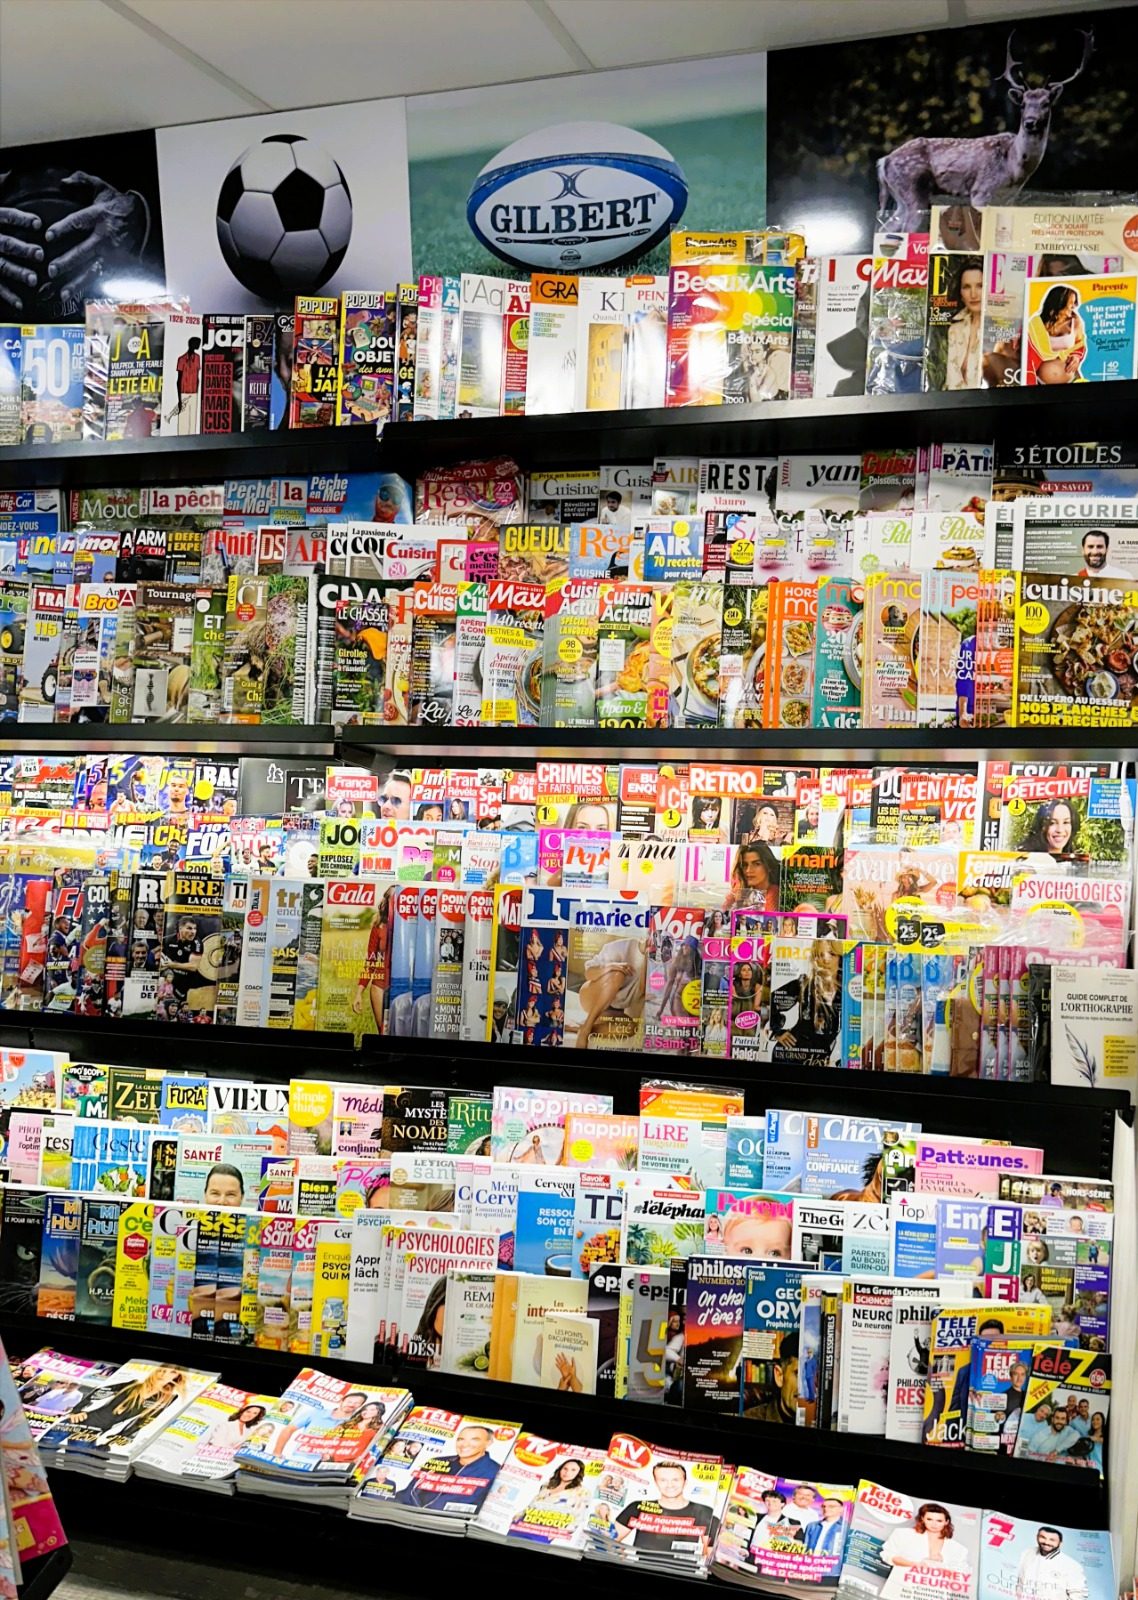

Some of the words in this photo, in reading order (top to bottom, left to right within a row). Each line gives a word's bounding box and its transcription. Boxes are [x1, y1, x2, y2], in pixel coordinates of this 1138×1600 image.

[490, 193, 656, 234] GILBERT
[673, 269, 797, 296] BeauxArts
[1092, 282, 1129, 292] Parents
[345, 294, 363, 308] POP
[1086, 304, 1103, 314] Mon
[1104, 302, 1136, 314] carnet
[1093, 312, 1104, 321] de
[1105, 311, 1126, 320] bord
[23, 338, 70, 398] 50
[204, 363, 232, 376] MILES
[204, 376, 231, 389] DAVIS
[204, 396, 231, 411] MAR
[204, 411, 230, 430] CUS
[1014, 447, 1026, 465] 3
[1028, 444, 1123, 465] ÉTOILES
[310, 473, 348, 491] Pêche
[543, 477, 599, 496] Cuisine
[1041, 482, 1060, 491] GUY
[1061, 483, 1093, 492] SAVOY
[283, 483, 303, 500] la
[309, 490, 321, 500] en
[322, 486, 347, 502] Mer
[152, 490, 170, 508] la
[713, 496, 746, 507] Mauro
[352, 527, 361, 535] La
[361, 528, 385, 537] passion
[386, 530, 397, 538] des
[648, 535, 692, 557] AIR
[737, 542, 751, 553] 57
[653, 556, 665, 568] 70
[573, 568, 611, 579] CUISINE
[664, 571, 680, 580] pour
[1026, 578, 1124, 605] cuisine
[337, 607, 348, 620] LE
[1025, 605, 1043, 618] 100
[203, 614, 225, 629] ET
[494, 613, 514, 627] 140
[487, 626, 515, 637] FESTIVES
[565, 639, 577, 649] 98
[338, 648, 368, 659] Girolles
[1019, 694, 1033, 703] DE
[1033, 694, 1074, 704] L'APÉRO
[1075, 697, 1089, 705] AU
[1089, 698, 1131, 708] DESSERT
[1019, 702, 1050, 714] NOS
[1052, 703, 1129, 719] PLANCHES
[1019, 713, 1062, 726] POUR
[1064, 714, 1133, 728] RECEVOIR
[538, 764, 603, 784] CRIMES
[689, 767, 758, 793] RETRO
[334, 778, 373, 789] France
[538, 783, 549, 793] ET
[550, 784, 572, 794] FAITS
[573, 785, 602, 796] DIVERS
[1007, 778, 1089, 799] DÉTECTIVE
[328, 787, 376, 800] Semaine
[320, 854, 354, 865] EXPLOSEZ
[362, 857, 373, 870] 10
[374, 857, 392, 870] KM
[187, 864, 208, 874] 200
[327, 882, 375, 905] Gala
[1018, 880, 1123, 902] PSYCHOLOGIES
[188, 896, 199, 905] LA
[575, 908, 632, 928] marie
[142, 984, 156, 993] ILS
[1067, 992, 1084, 1002] GUIDE
[1085, 993, 1114, 1002] COMPLET
[1114, 995, 1128, 1003] DE
[1060, 1001, 1133, 1015] L'ORTHOGRAPHE
[645, 1024, 663, 1037] Elle
[673, 1027, 692, 1038] mis
[430, 1100, 445, 1109] LES
[429, 1117, 444, 1126] DES
[183, 1146, 222, 1162] SANTÉ
[641, 1154, 657, 1163] TOUS
[657, 1155, 668, 1163] LES
[668, 1156, 690, 1164] LIVRES
[807, 1162, 860, 1175] CONFIANCE
[301, 1182, 330, 1193] Bien
[1066, 1188, 1112, 1199] HORS-SÉRIE
[300, 1192, 320, 1200] Notre
[800, 1210, 828, 1225] The
[273, 1219, 293, 1231] TOP
[398, 1230, 495, 1256] PSYCHOLOGIES
[851, 1248, 887, 1259] PARENTS
[851, 1256, 863, 1264] AU
[864, 1257, 886, 1265] BORD
[88, 1287, 104, 1297] H.P.
[856, 1285, 870, 1294] Les
[871, 1286, 902, 1297] Grands
[902, 1287, 938, 1298] Dossiers
[698, 1290, 722, 1308] On
[765, 1318, 791, 1329] Prophète
[937, 1315, 977, 1330] TÉLÉ
[826, 1315, 836, 1354] ESSENTIELS
[984, 1353, 1018, 1370] TÉLÉ
[1067, 1349, 1098, 1385] Z
[310, 1372, 348, 1395] Télé
[1031, 1384, 1052, 1401] TNT
[421, 1407, 462, 1424] TÉLÉ
[174, 1417, 210, 1437] GUIDE
[414, 1425, 454, 1439] SEMAINES
[525, 1436, 560, 1456] TV
[616, 1437, 645, 1462] TV
[868, 1484, 902, 1508] Télé
[859, 1491, 914, 1522] Loisirs
[523, 1514, 569, 1529] DEMOUY
[525, 1507, 574, 1523] VANESSA
[640, 1512, 654, 1523] Un
[655, 1515, 693, 1527] nouveau
[630, 1520, 661, 1533] départ
[661, 1525, 706, 1537] inattendu
[909, 1565, 972, 1584] AUDREY
[903, 1573, 971, 1594] FLEUROT
